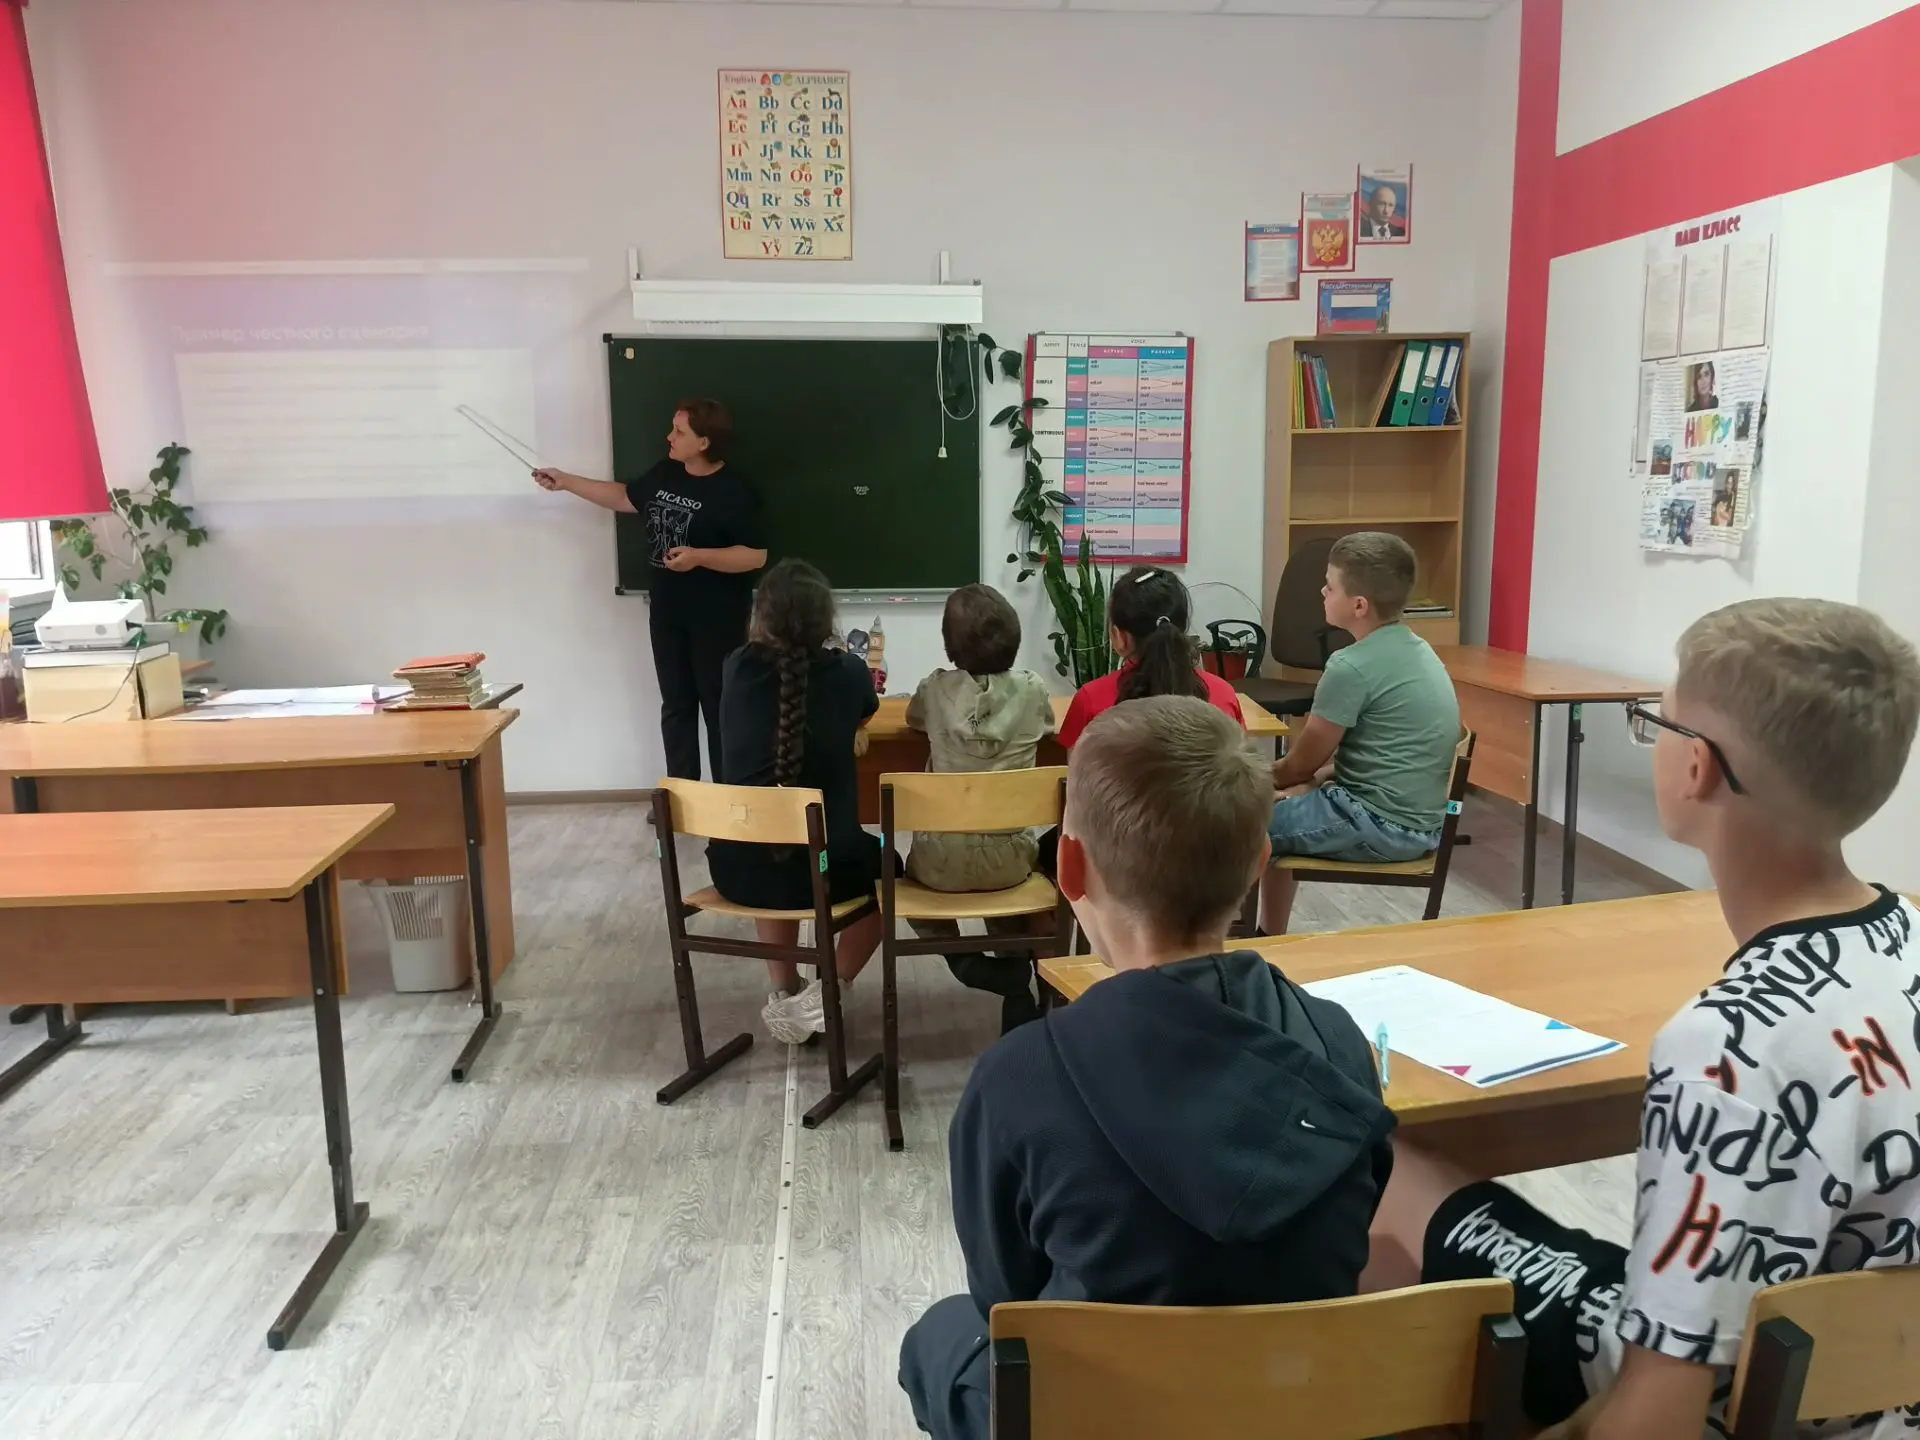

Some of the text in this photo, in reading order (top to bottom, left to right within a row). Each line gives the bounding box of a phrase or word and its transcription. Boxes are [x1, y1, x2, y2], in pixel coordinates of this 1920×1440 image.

[759, 95, 779, 109] Bb
[790, 95, 810, 110] Cc
[822, 96, 843, 110] Dd
[728, 120, 748, 134] Ee
[788, 120, 810, 138] Gg
[822, 121, 844, 135] Hh
[760, 144, 774, 161] Jj
[790, 145, 812, 158] Kk
[726, 167, 843, 186] Mm Nn Oo Pp
[726, 191, 749, 209] Qq
[762, 193, 781, 207] Rr
[794, 193, 811, 207] Ss
[730, 217, 751, 231] Uu
[795, 242, 813, 255] Zz
[655, 489, 702, 510] PICASSO
